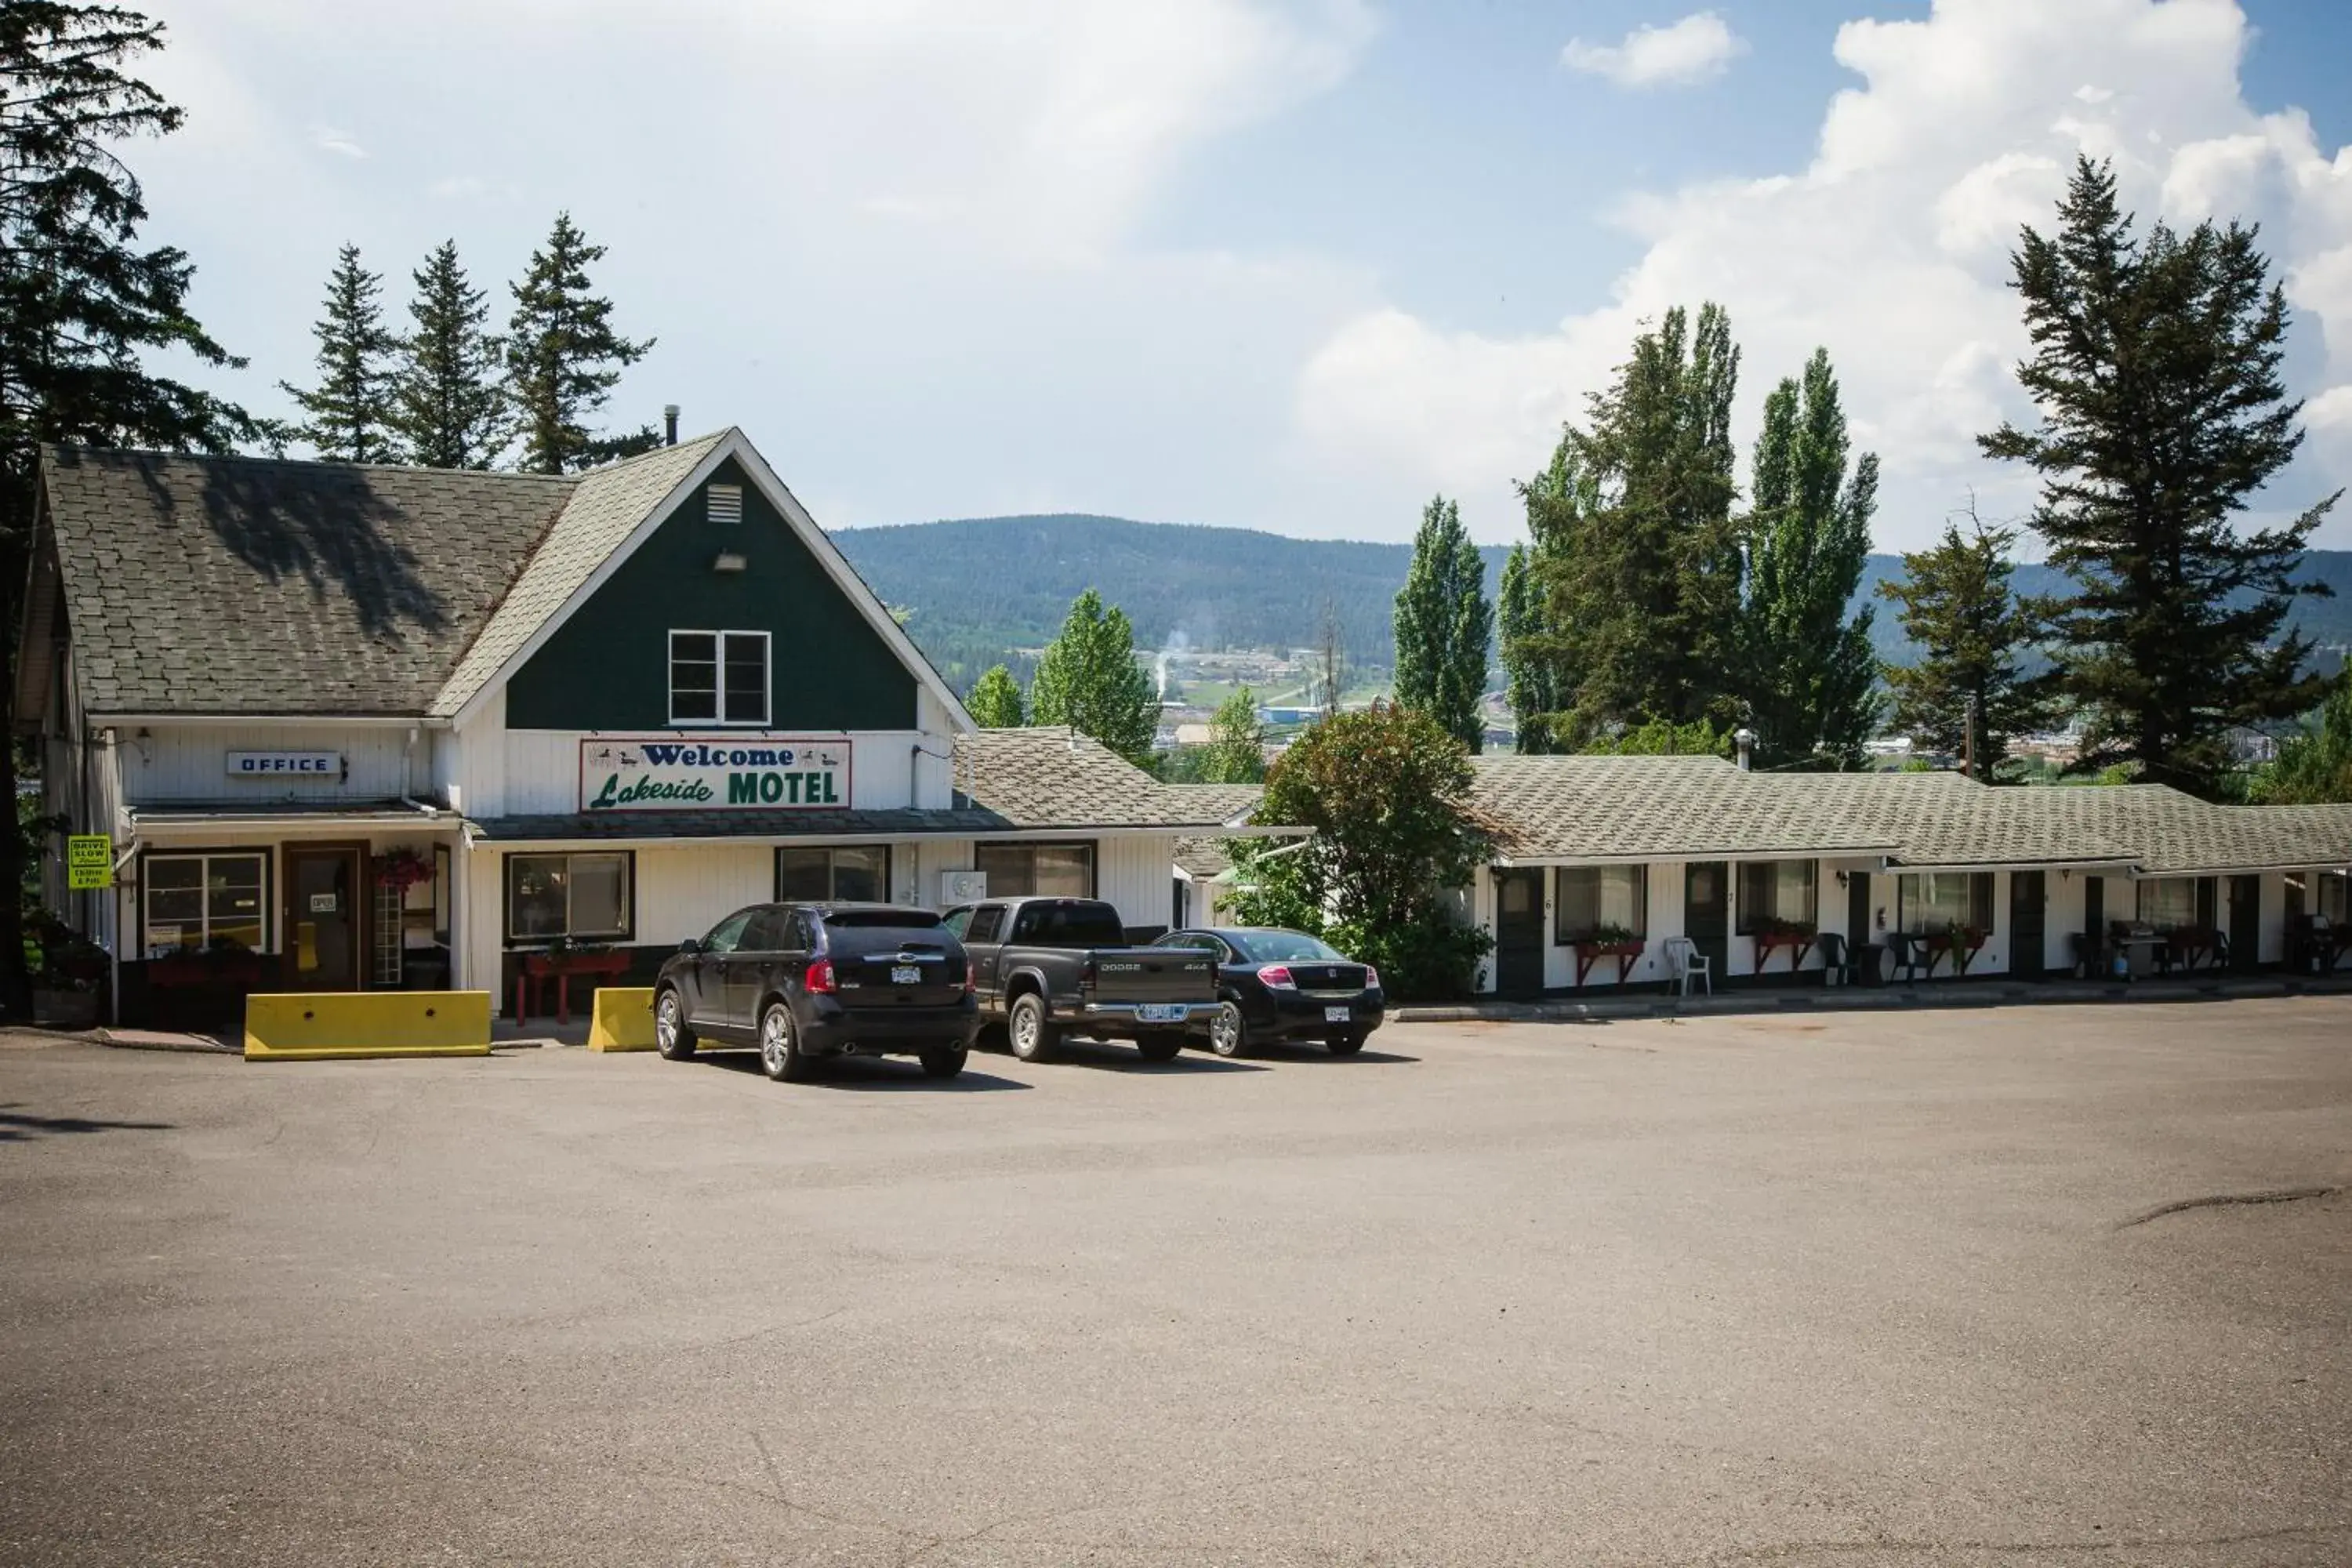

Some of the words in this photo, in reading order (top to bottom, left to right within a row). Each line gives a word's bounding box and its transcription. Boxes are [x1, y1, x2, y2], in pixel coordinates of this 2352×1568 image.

[241, 759, 327, 771] OFFICE
[640, 744, 794, 766] Welcome
[590, 773, 714, 808] Lakeside
[728, 771, 839, 804] MOTEL
